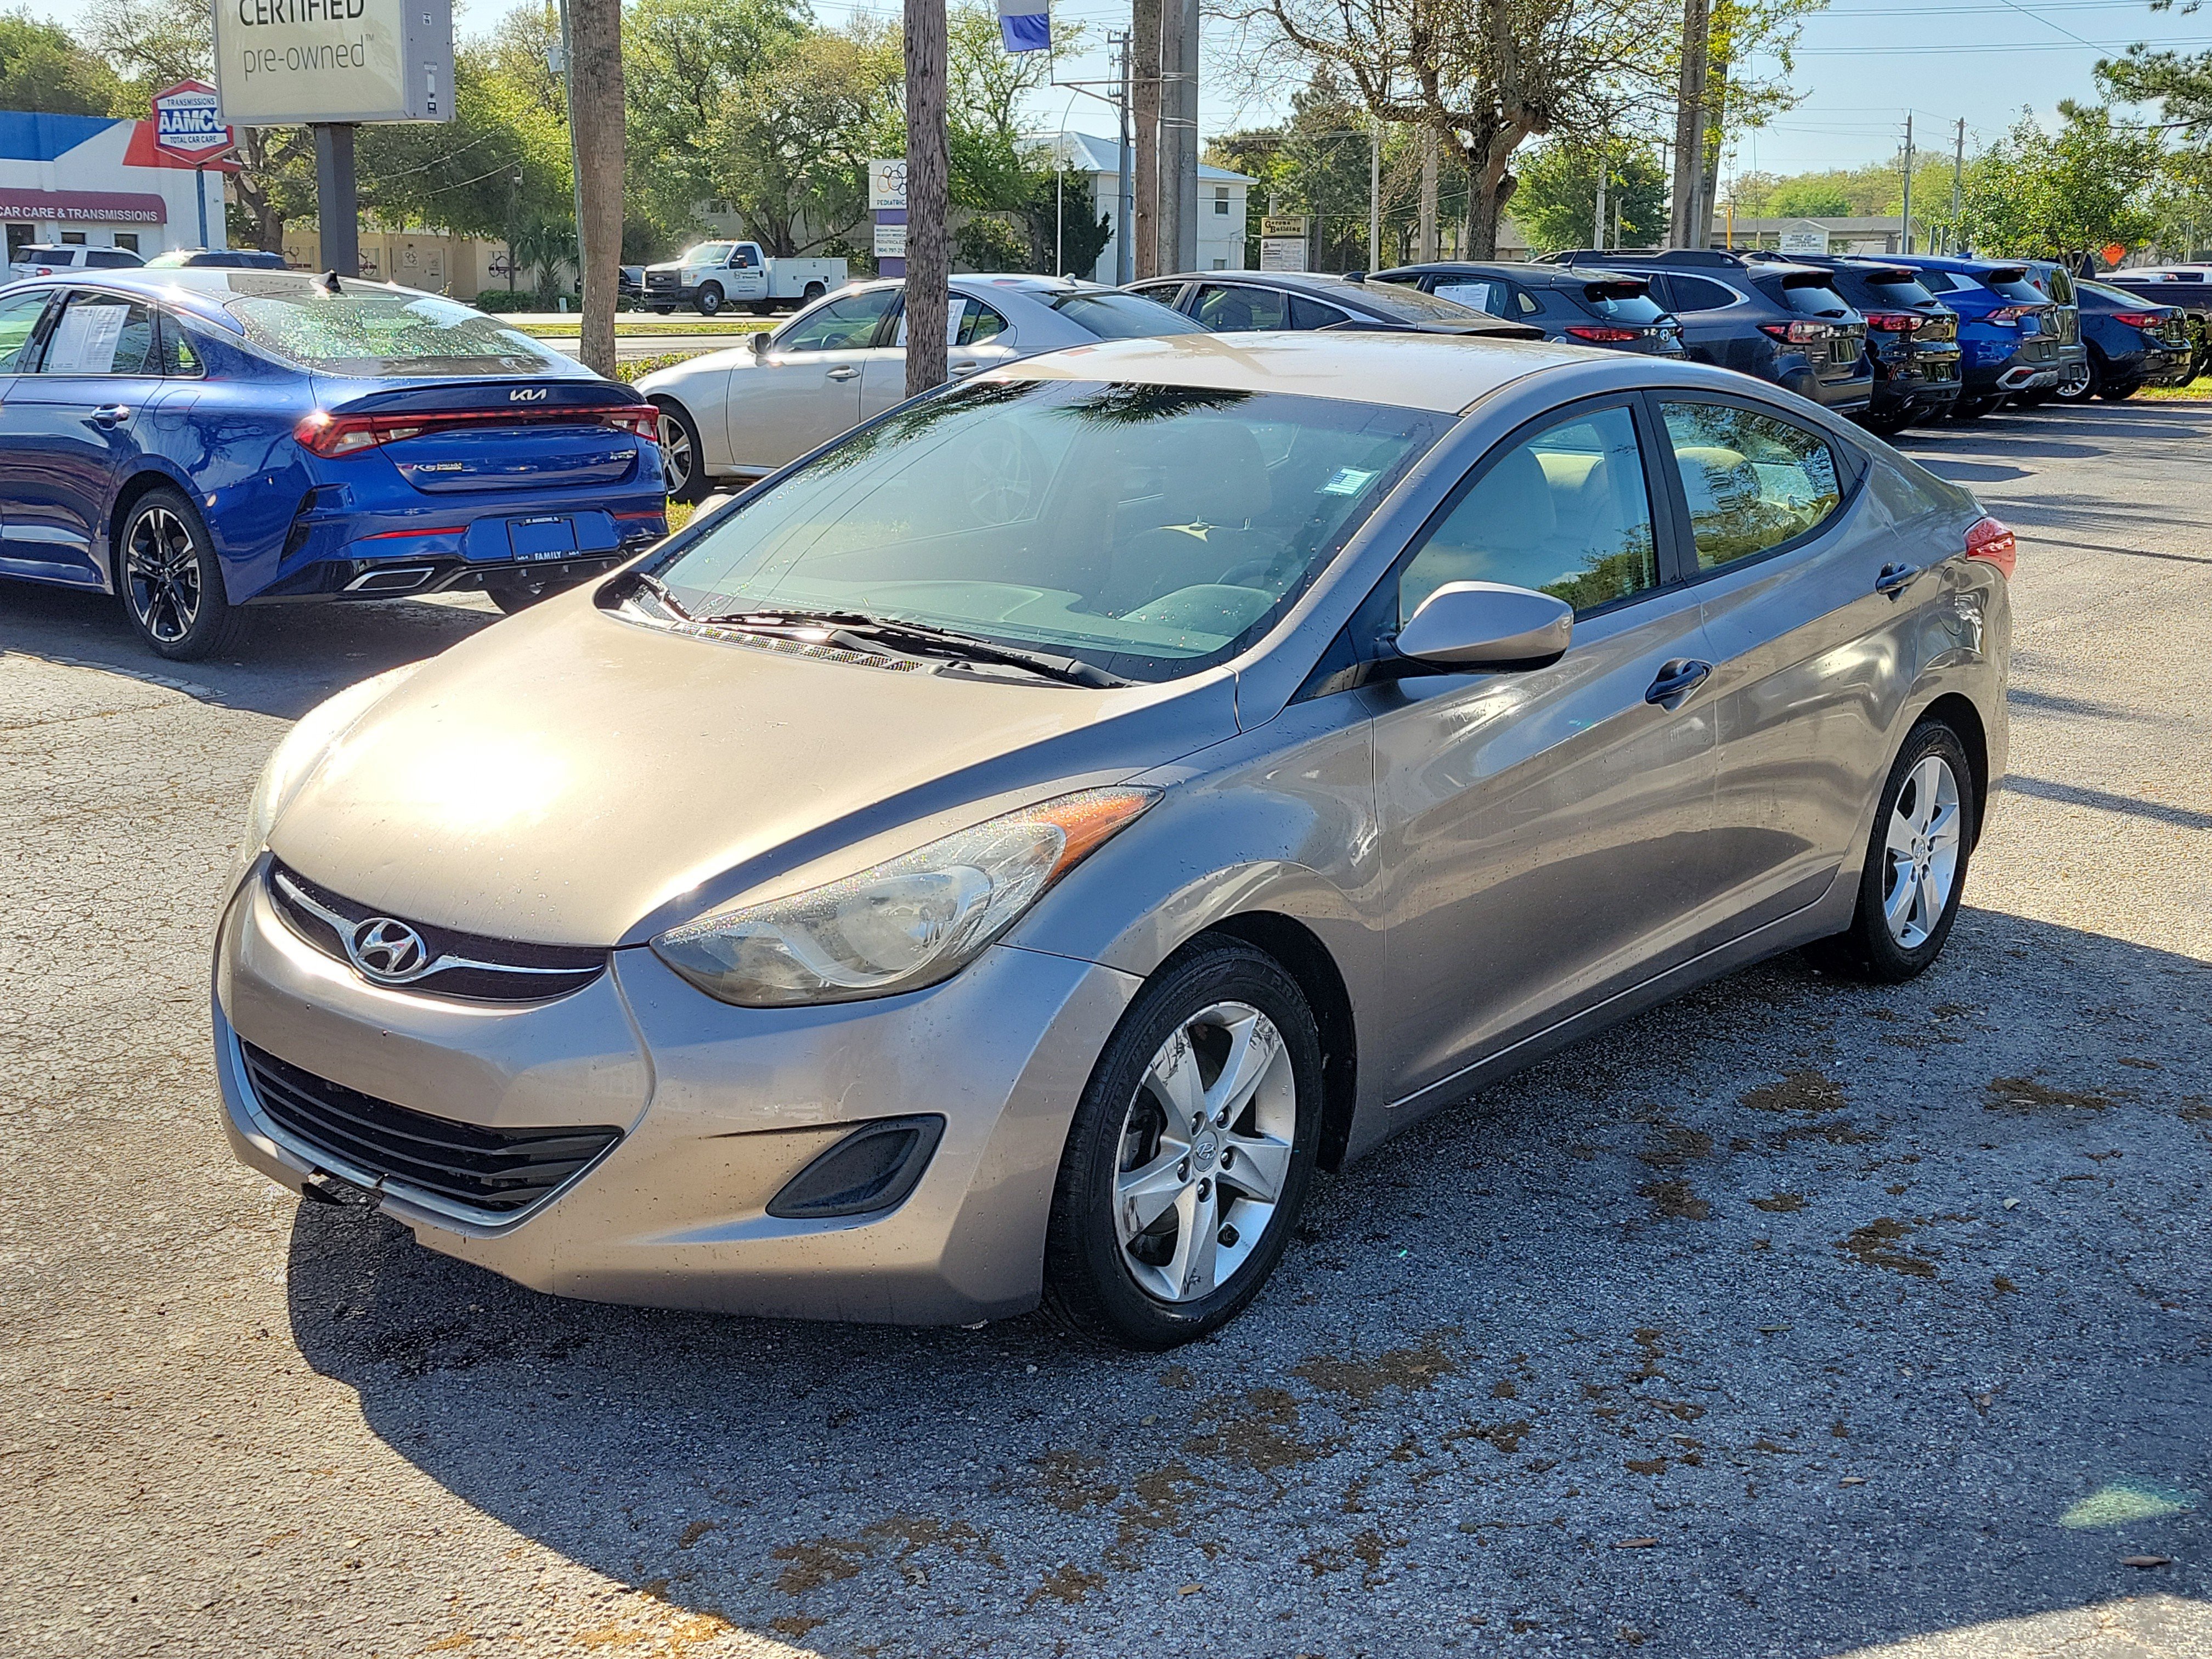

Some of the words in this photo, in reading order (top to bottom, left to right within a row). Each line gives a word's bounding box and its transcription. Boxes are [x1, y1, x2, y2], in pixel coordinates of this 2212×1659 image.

[239, 0, 364, 26] CERTIFIED
[167, 98, 215, 106] TRANSMISSIONS
[22, 207, 55, 218] CARE
[57, 208, 65, 218] &
[66, 208, 157, 221] TRANSMISSIONS
[510, 388, 547, 401] KIA
[534, 550, 562, 561] FAMILY
